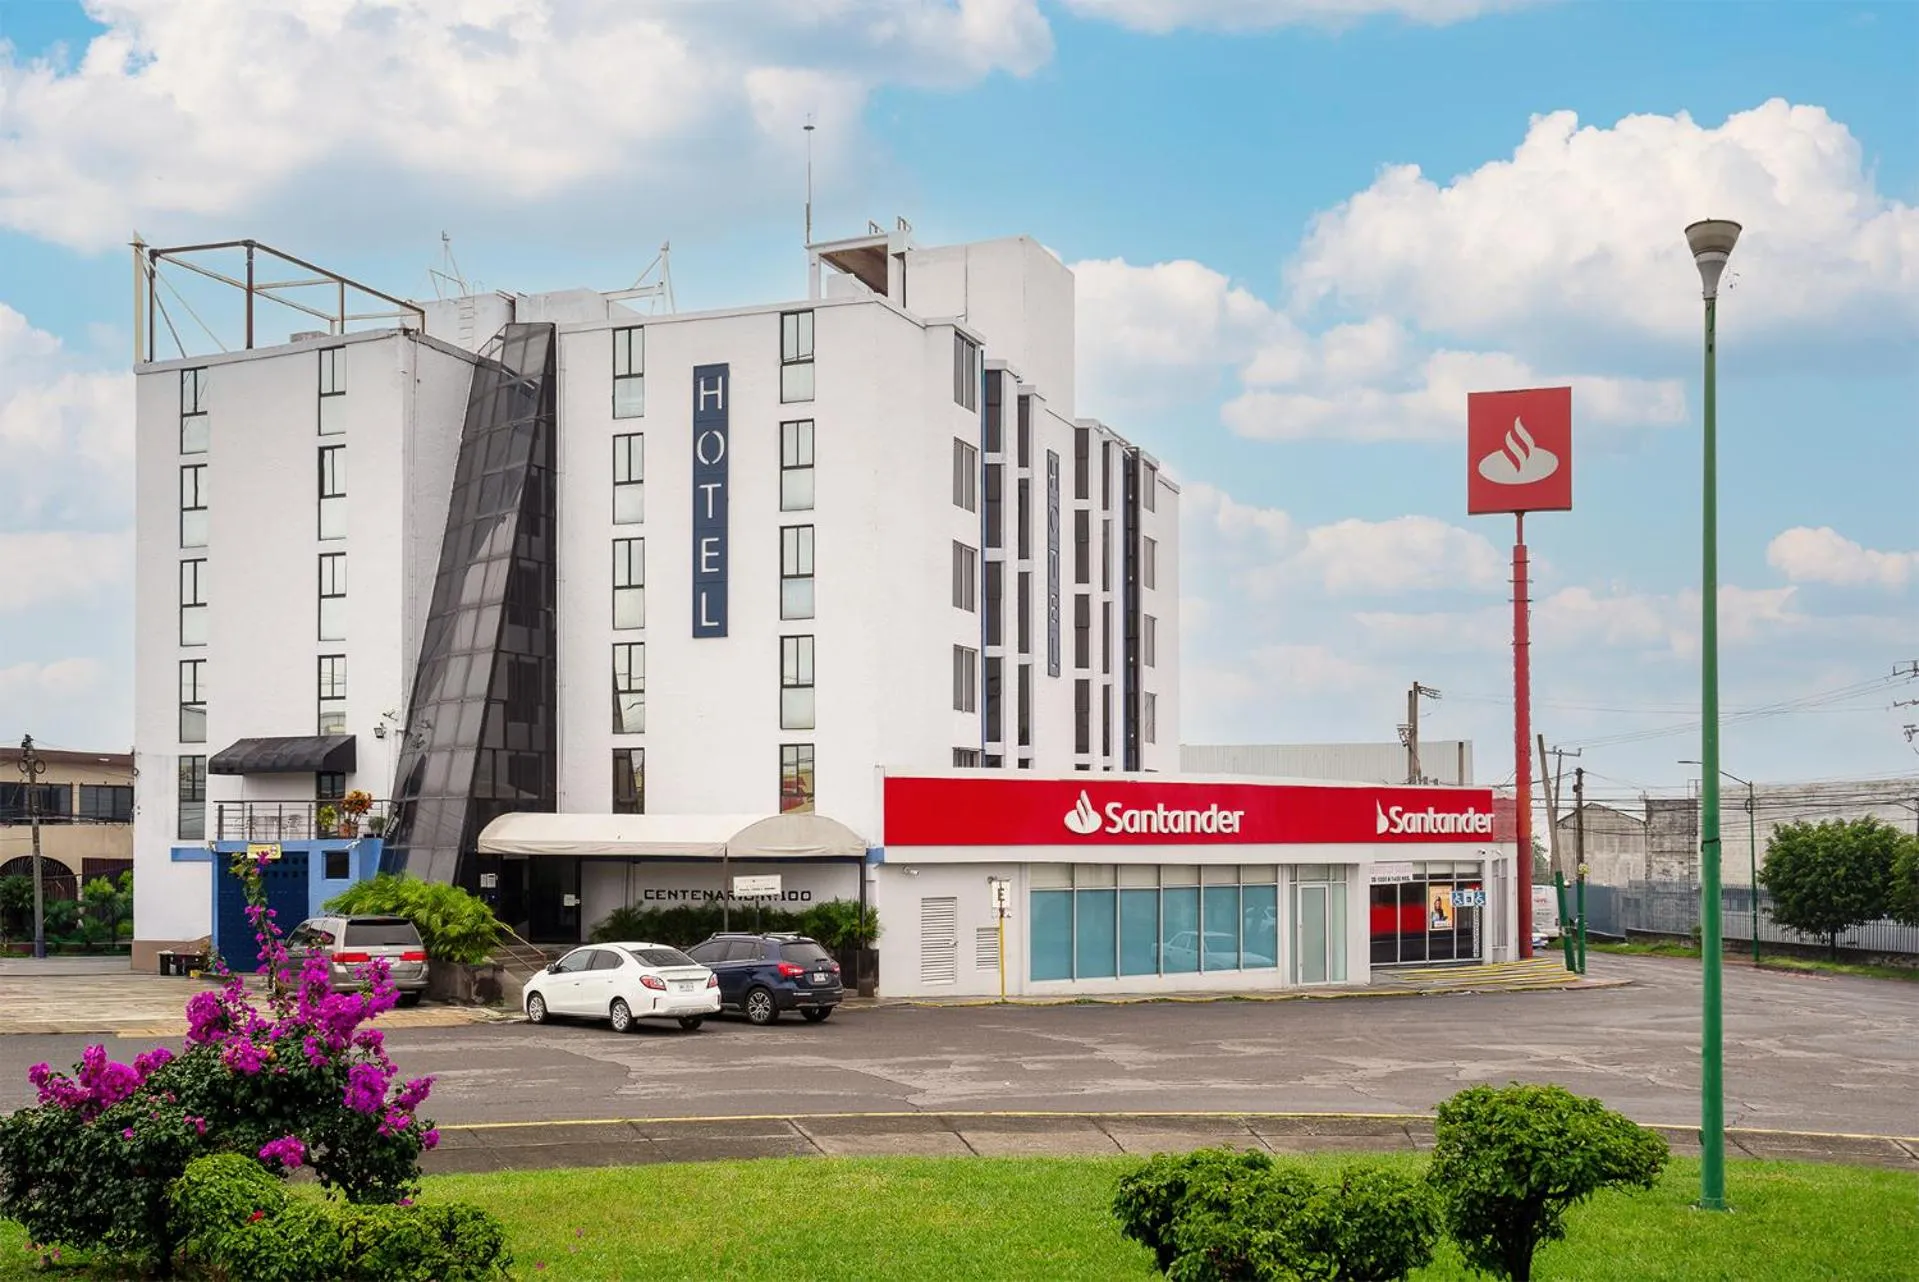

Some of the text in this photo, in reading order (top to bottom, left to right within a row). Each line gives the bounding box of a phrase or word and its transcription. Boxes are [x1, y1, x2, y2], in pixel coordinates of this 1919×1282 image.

[696, 375, 725, 627] HOTEL
[1049, 456, 1059, 668] HOTEL
[1105, 801, 1245, 834] Santander
[1389, 805, 1495, 834] Santander
